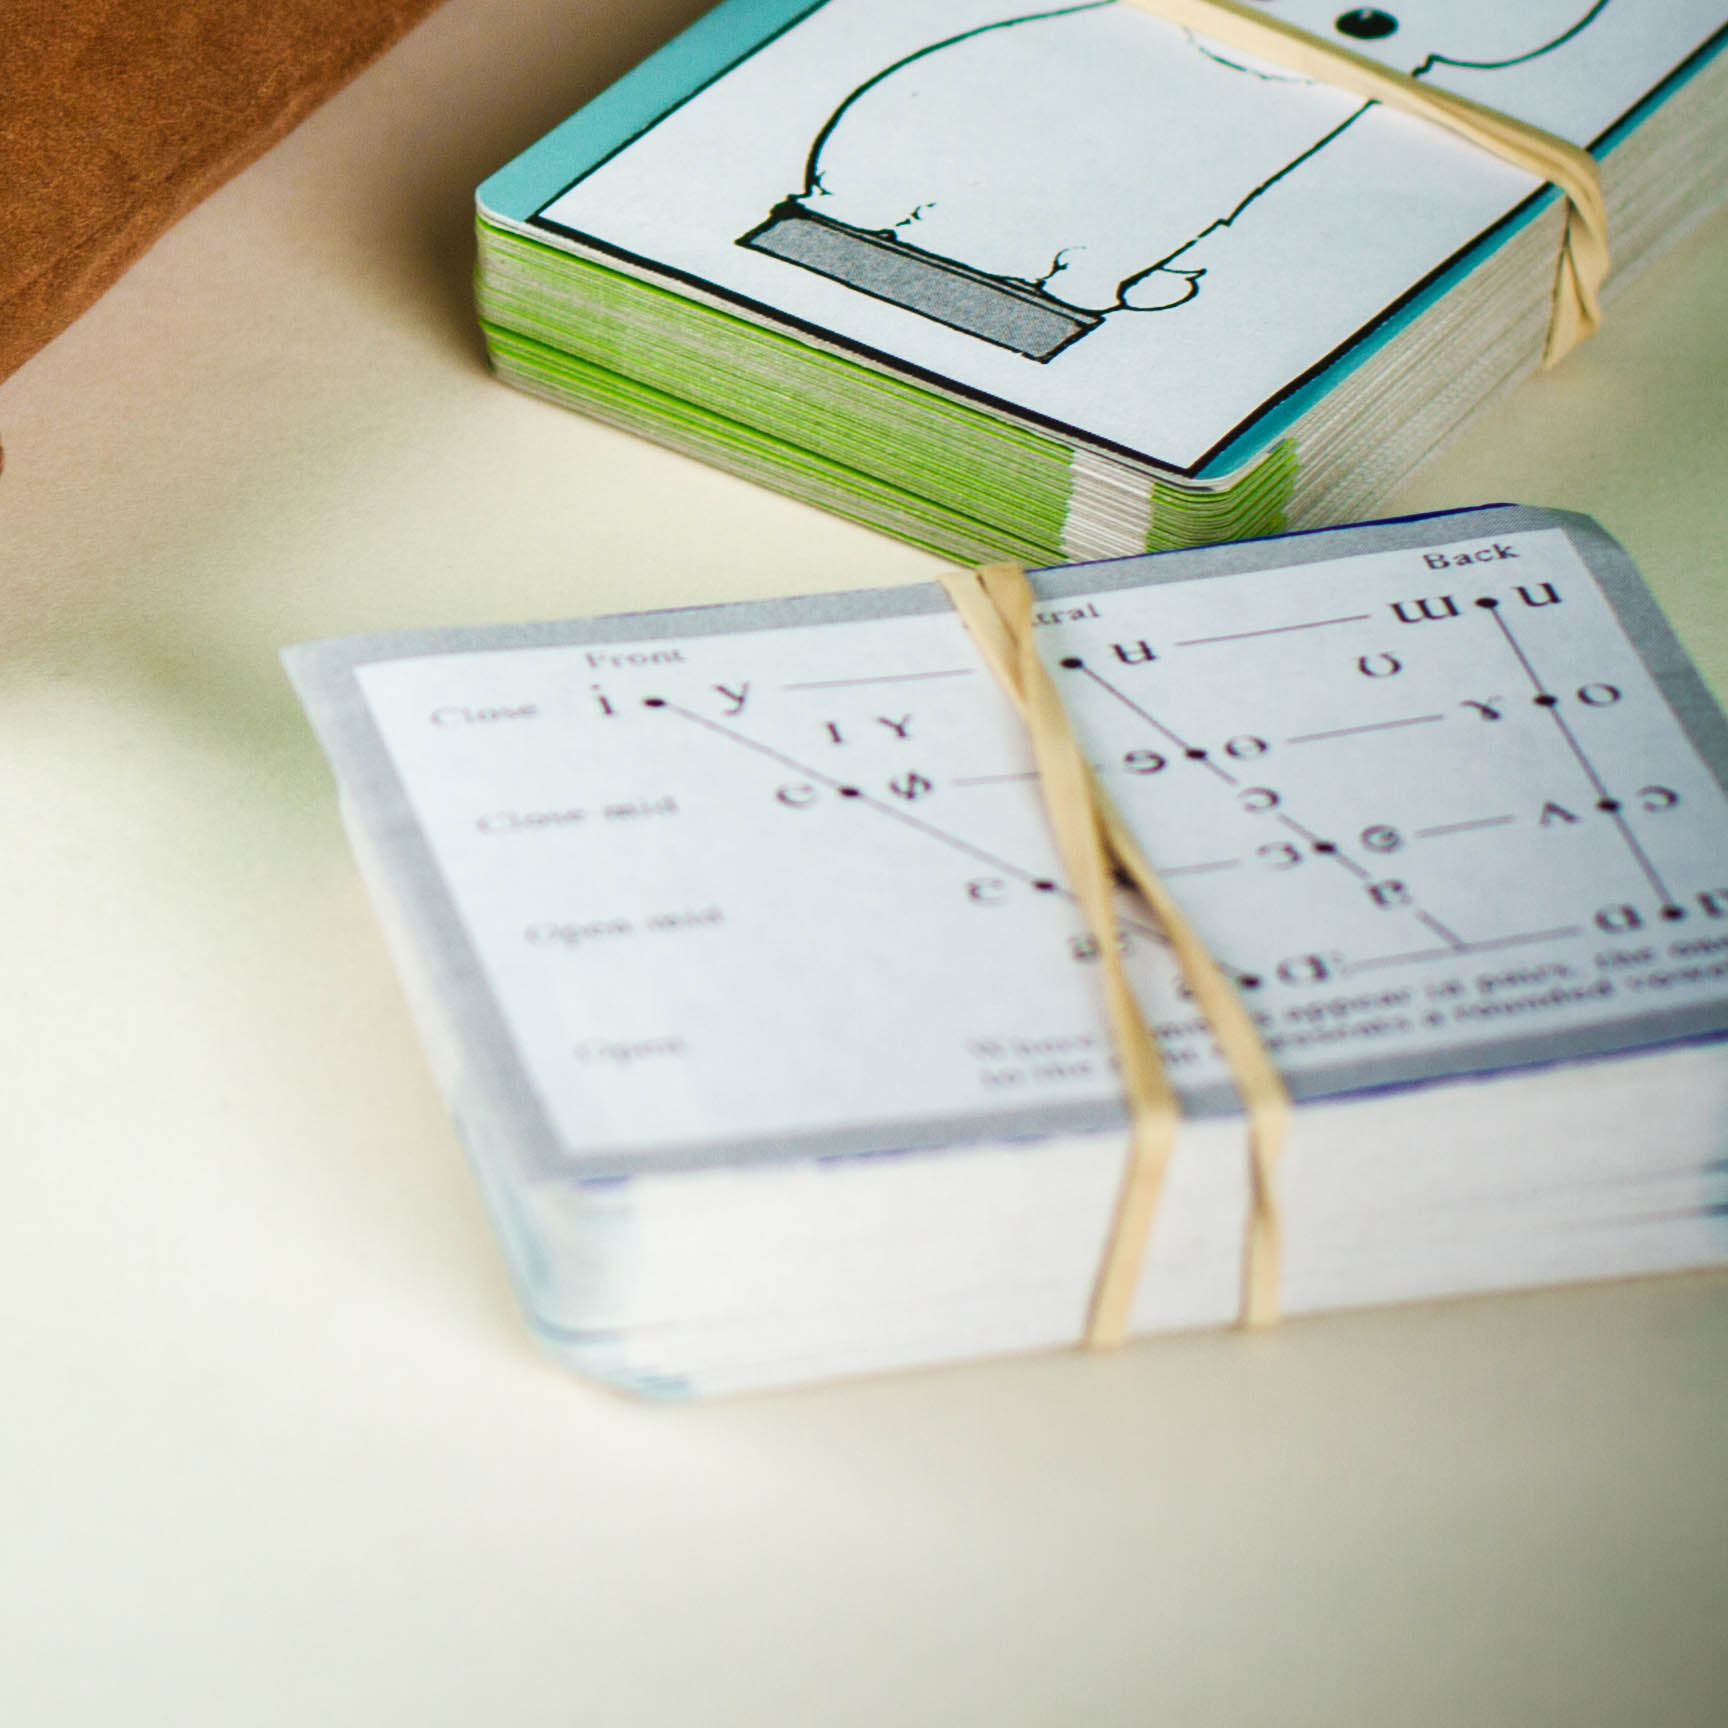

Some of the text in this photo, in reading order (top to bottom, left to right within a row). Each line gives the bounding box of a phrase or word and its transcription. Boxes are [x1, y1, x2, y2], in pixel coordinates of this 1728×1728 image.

[1422, 543, 1521, 571] Back
[584, 648, 687, 669] Front
[430, 703, 538, 725] Close
[591, 683, 614, 716] i
[712, 682, 750, 717] y
